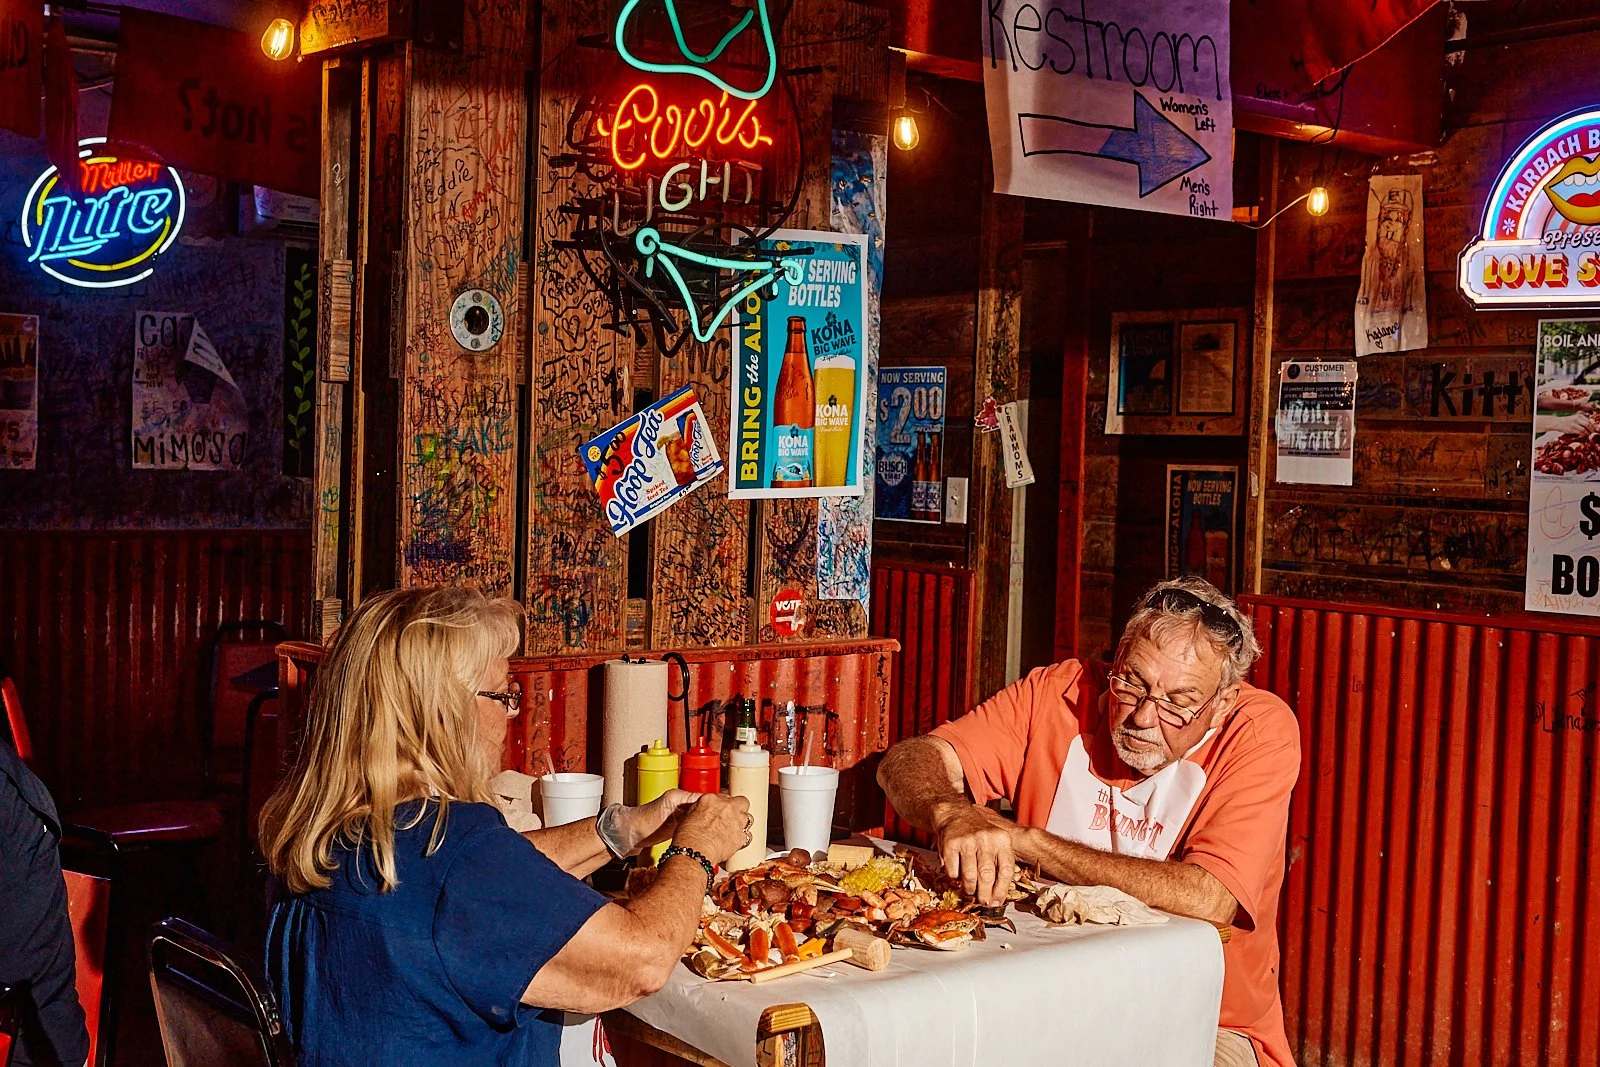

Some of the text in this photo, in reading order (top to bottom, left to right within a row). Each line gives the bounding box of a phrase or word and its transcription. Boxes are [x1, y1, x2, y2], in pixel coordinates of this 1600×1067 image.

[1160, 97, 1209, 116] Women's
[1195, 117, 1216, 132] Left
[80, 160, 162, 192] Miller
[1506, 133, 1582, 214] KARBACH
[1179, 176, 1210, 196] Men's
[614, 159, 763, 237] LIGHT
[1189, 195, 1219, 217] Right
[808, 259, 856, 284] SERVING
[1483, 252, 1569, 289] LOVE
[788, 284, 841, 308] BOTTLES
[811, 319, 854, 345] KONA
[1543, 334, 1574, 347] BOIL
[813, 335, 857, 356] BIG WAVE
[745, 355, 759, 385] the
[881, 372, 944, 384] NOW SERVING
[1305, 364, 1344, 372] CUSTOMER
[816, 404, 848, 417] KONA
[816, 418, 848, 426] BIG WAVE
[741, 387, 762, 481] BRING
[778, 435, 808, 448] KONA
[1003, 406, 1023, 479] CRAWMOMS
[778, 448, 809, 456] BIG WAVE
[608, 411, 663, 525] Hoop Tea
[878, 459, 907, 475] BUSCH
[646, 480, 666, 494] Spiked
[647, 491, 659, 501] Iced
[659, 486, 669, 495] Tea
[1187, 480, 1232, 493] NOW SERVING
[1171, 474, 1182, 529] ALOHA
[1192, 494, 1222, 506] BOTTLES
